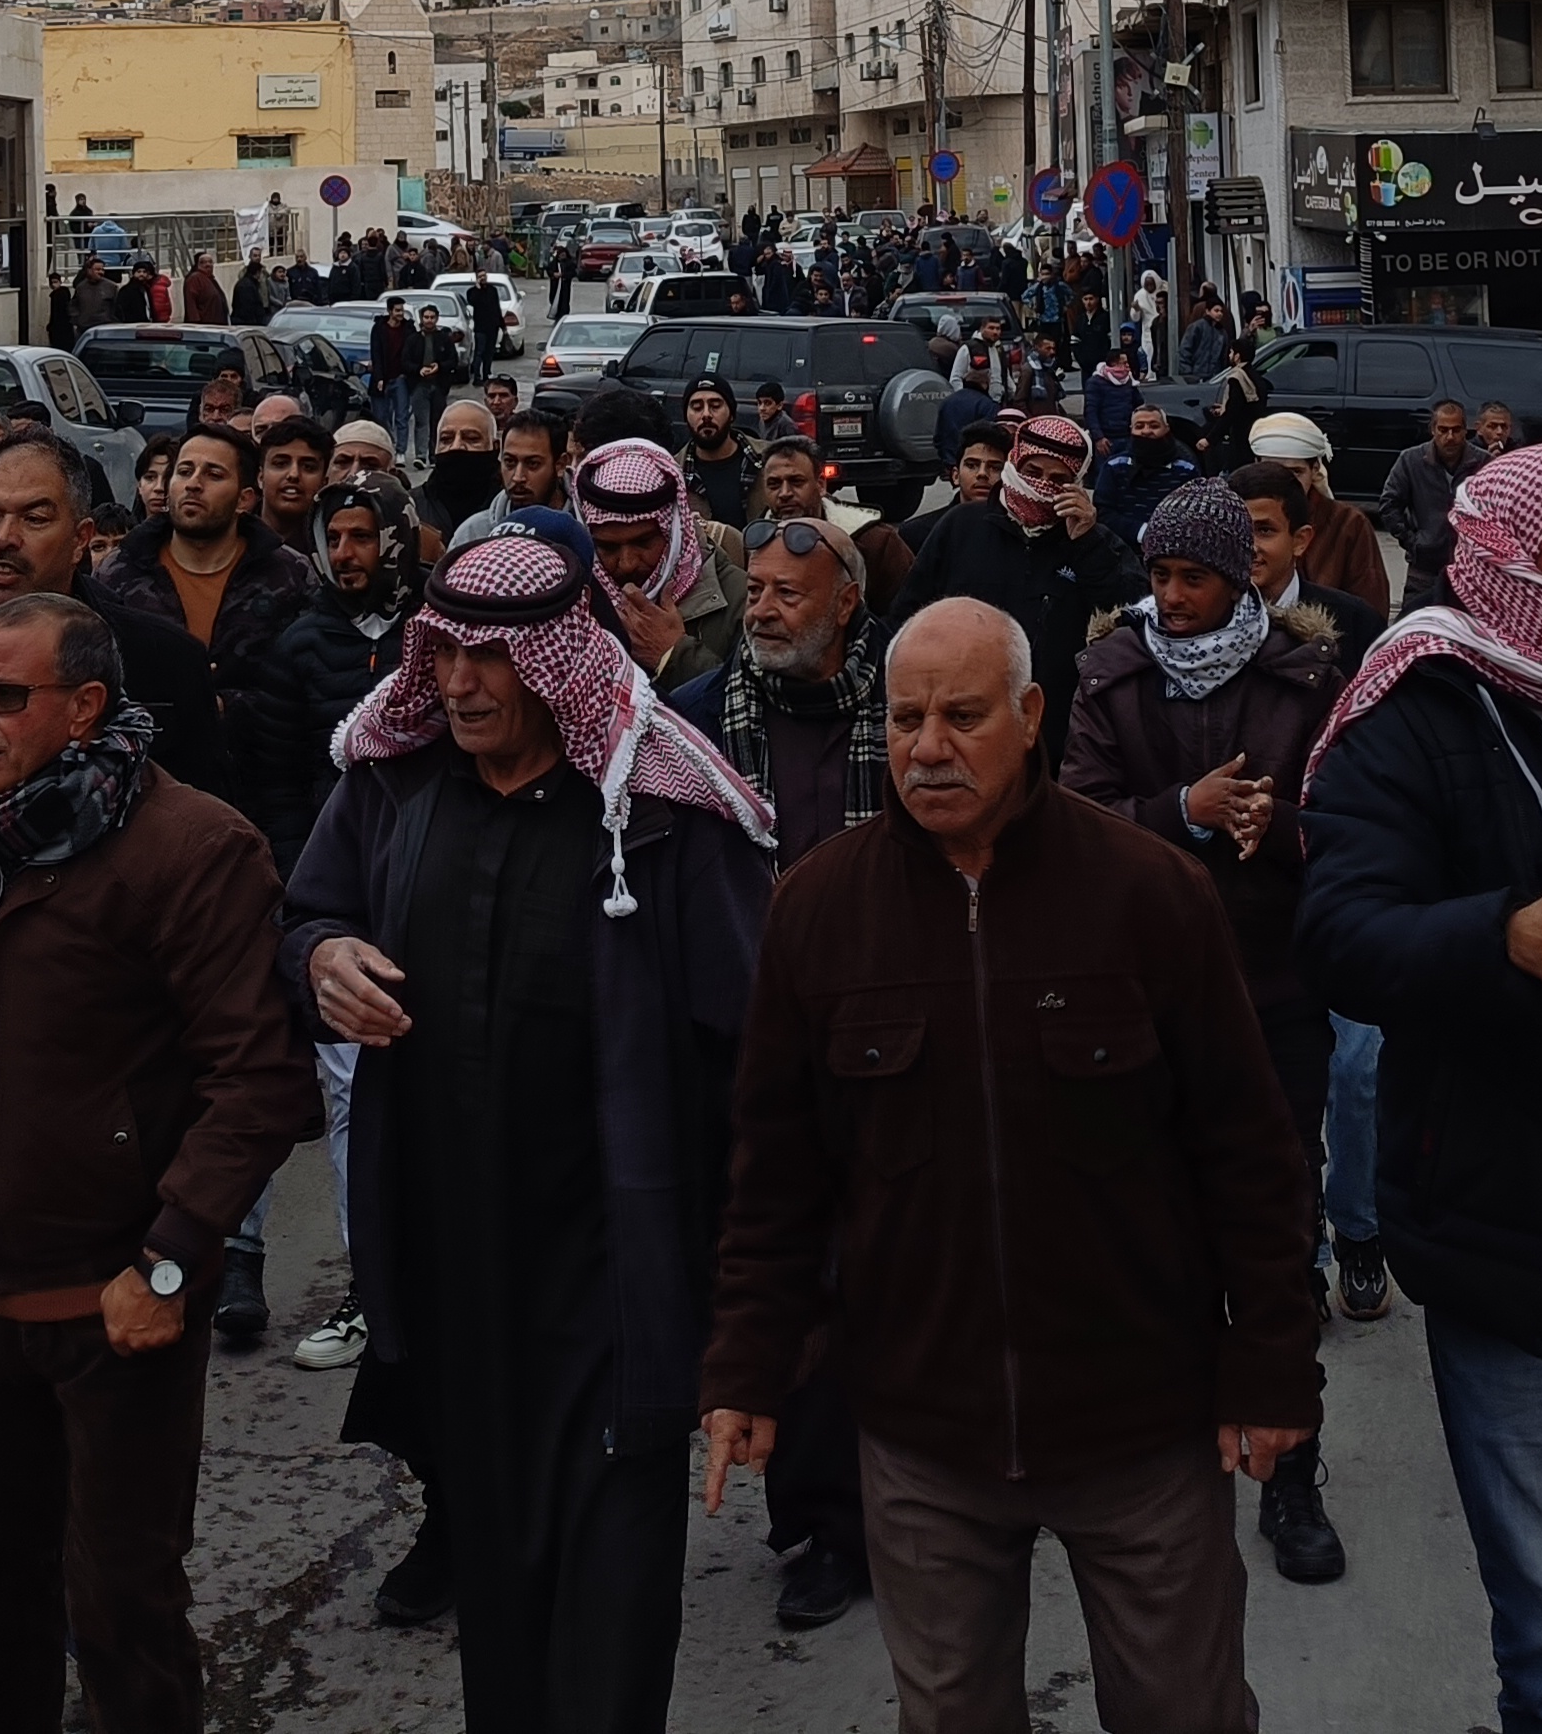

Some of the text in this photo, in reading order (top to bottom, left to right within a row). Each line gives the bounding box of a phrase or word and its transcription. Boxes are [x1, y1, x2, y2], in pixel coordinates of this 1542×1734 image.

[1189, 169, 1217, 179] Center
[1381, 254, 1412, 272] TO
[1419, 252, 1450, 272] BE
[1455, 251, 1489, 270] OR
[1495, 249, 1541, 268] NOT
[908, 390, 957, 401] PATRO
